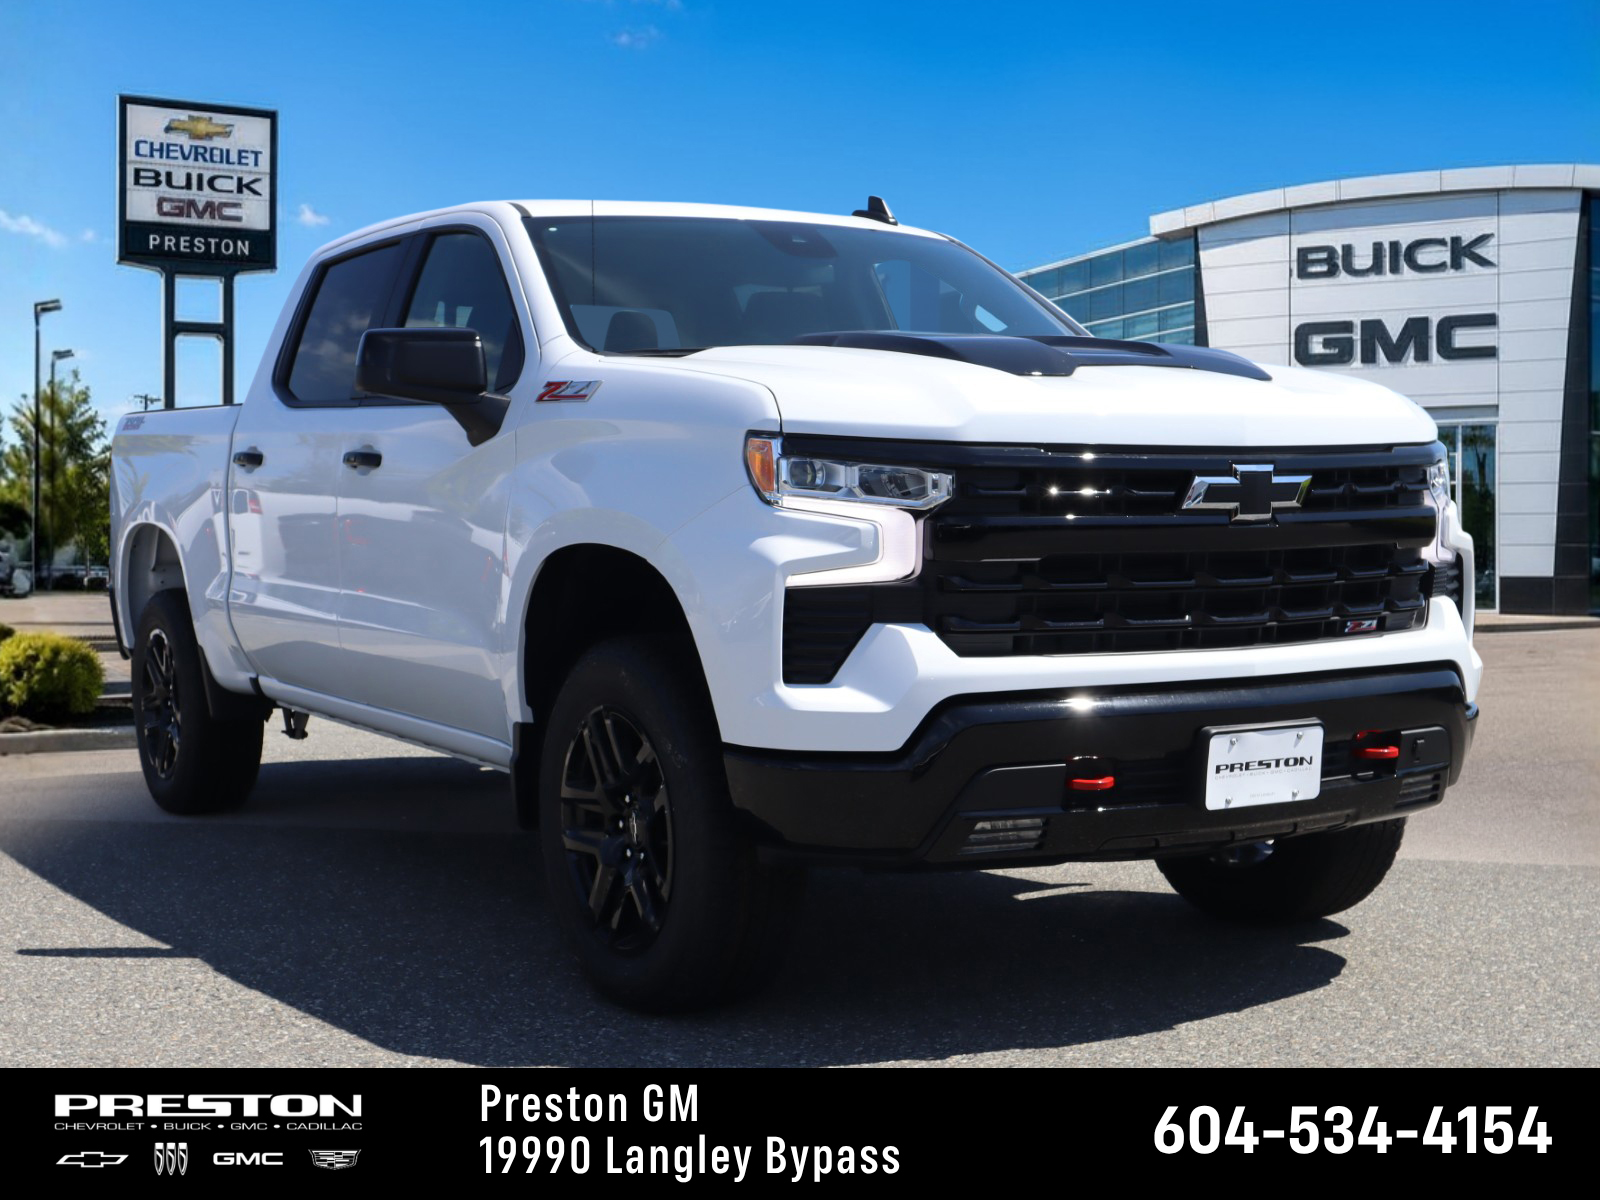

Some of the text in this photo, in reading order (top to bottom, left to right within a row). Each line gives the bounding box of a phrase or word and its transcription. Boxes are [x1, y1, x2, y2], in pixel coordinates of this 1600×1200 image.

[134, 139, 263, 167] CHEVROLET
[133, 167, 262, 197] BUICK
[156, 196, 243, 222] GMC
[149, 234, 250, 256] PRESTON
[1297, 233, 1497, 279] BUICK
[1294, 312, 1497, 366] GMC
[1215, 756, 1313, 774] PRESTON
